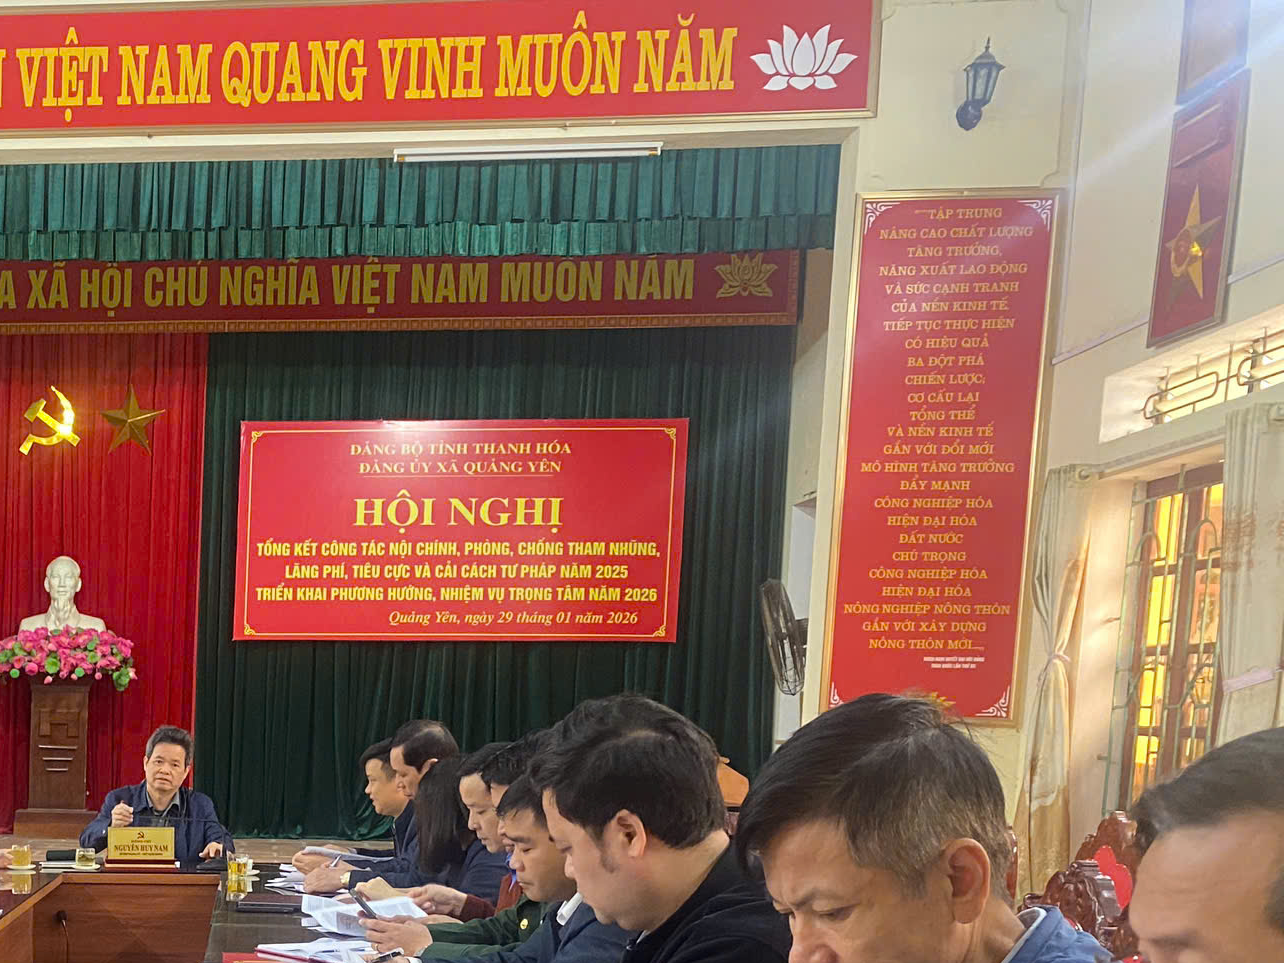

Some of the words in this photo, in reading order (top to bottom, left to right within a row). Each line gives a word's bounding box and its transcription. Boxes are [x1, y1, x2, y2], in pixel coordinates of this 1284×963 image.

[17, 27, 108, 122] VIỆT
[117, 44, 211, 106] NAM
[221, 39, 367, 107] QUANG
[379, 36, 485, 100] VINH
[496, 11, 626, 98] MUÔN
[634, 13, 738, 92] NĂM
[957, 208, 1002, 218] TRUNG
[960, 265, 986, 274] LAO
[28, 262, 69, 309] XÃ
[80, 263, 131, 317] HỘI
[220, 258, 319, 306] NGHĨA
[332, 257, 400, 313] VIỆT
[411, 263, 487, 303] NAM
[974, 282, 1019, 292] TRANH
[908, 357, 923, 366] BA
[350, 441, 396, 455] ĐẢNG
[401, 441, 423, 457] BỘ
[428, 440, 467, 455] TỈNH
[473, 442, 531, 454] THANH
[536, 440, 571, 454] HÓA
[359, 459, 404, 474] ĐẢNG
[410, 458, 432, 473] ỦY
[437, 459, 458, 473] XÃ
[464, 458, 522, 474] QUẢNG
[528, 458, 561, 473] YÊN
[353, 489, 436, 534] HỘI
[447, 497, 564, 533] NGHỊ
[257, 538, 290, 556] TỔNG
[295, 538, 318, 556] KẾT
[321, 540, 357, 556] CÔNG
[361, 539, 385, 556] TÁC
[389, 540, 412, 558] NỘI
[416, 540, 460, 557] CHÍNH,
[465, 539, 514, 556] PHÒNG,
[518, 537, 564, 556] CHỐNG
[568, 542, 605, 555] THAM
[609, 540, 660, 557] NHŨNG,
[922, 552, 966, 563] TRỌNG
[286, 563, 319, 579] LÃNG
[323, 562, 348, 579] PHÍ,
[352, 562, 380, 578] TIÊU
[384, 564, 410, 581] CỰC
[415, 562, 431, 578] VÀ
[435, 561, 457, 578] CẢI
[461, 562, 496, 578] CÁCH
[501, 563, 518, 578] TƯ
[521, 562, 556, 578] PHÁP
[560, 563, 591, 578] NĂM
[596, 565, 628, 578] 2025
[256, 582, 292, 600] TRIỂN
[297, 587, 327, 600] KHAI
[331, 586, 383, 600] PHƯƠNG
[388, 584, 436, 602] HƯỚNG,
[441, 585, 483, 603] NHIỆM
[488, 587, 504, 604] VỤ
[509, 588, 552, 604] TRỌNG
[556, 585, 584, 601] TÂM
[589, 585, 620, 600] NĂM
[625, 588, 657, 601] 2026
[389, 611, 430, 625] Quảng
[436, 611, 460, 624] Yên,
[465, 613, 494, 624] ngày
[497, 612, 513, 623] 29
[516, 612, 552, 624] tháng
[556, 612, 570, 623] 01
[575, 612, 603, 623] năm
[607, 612, 638, 623] 2026
